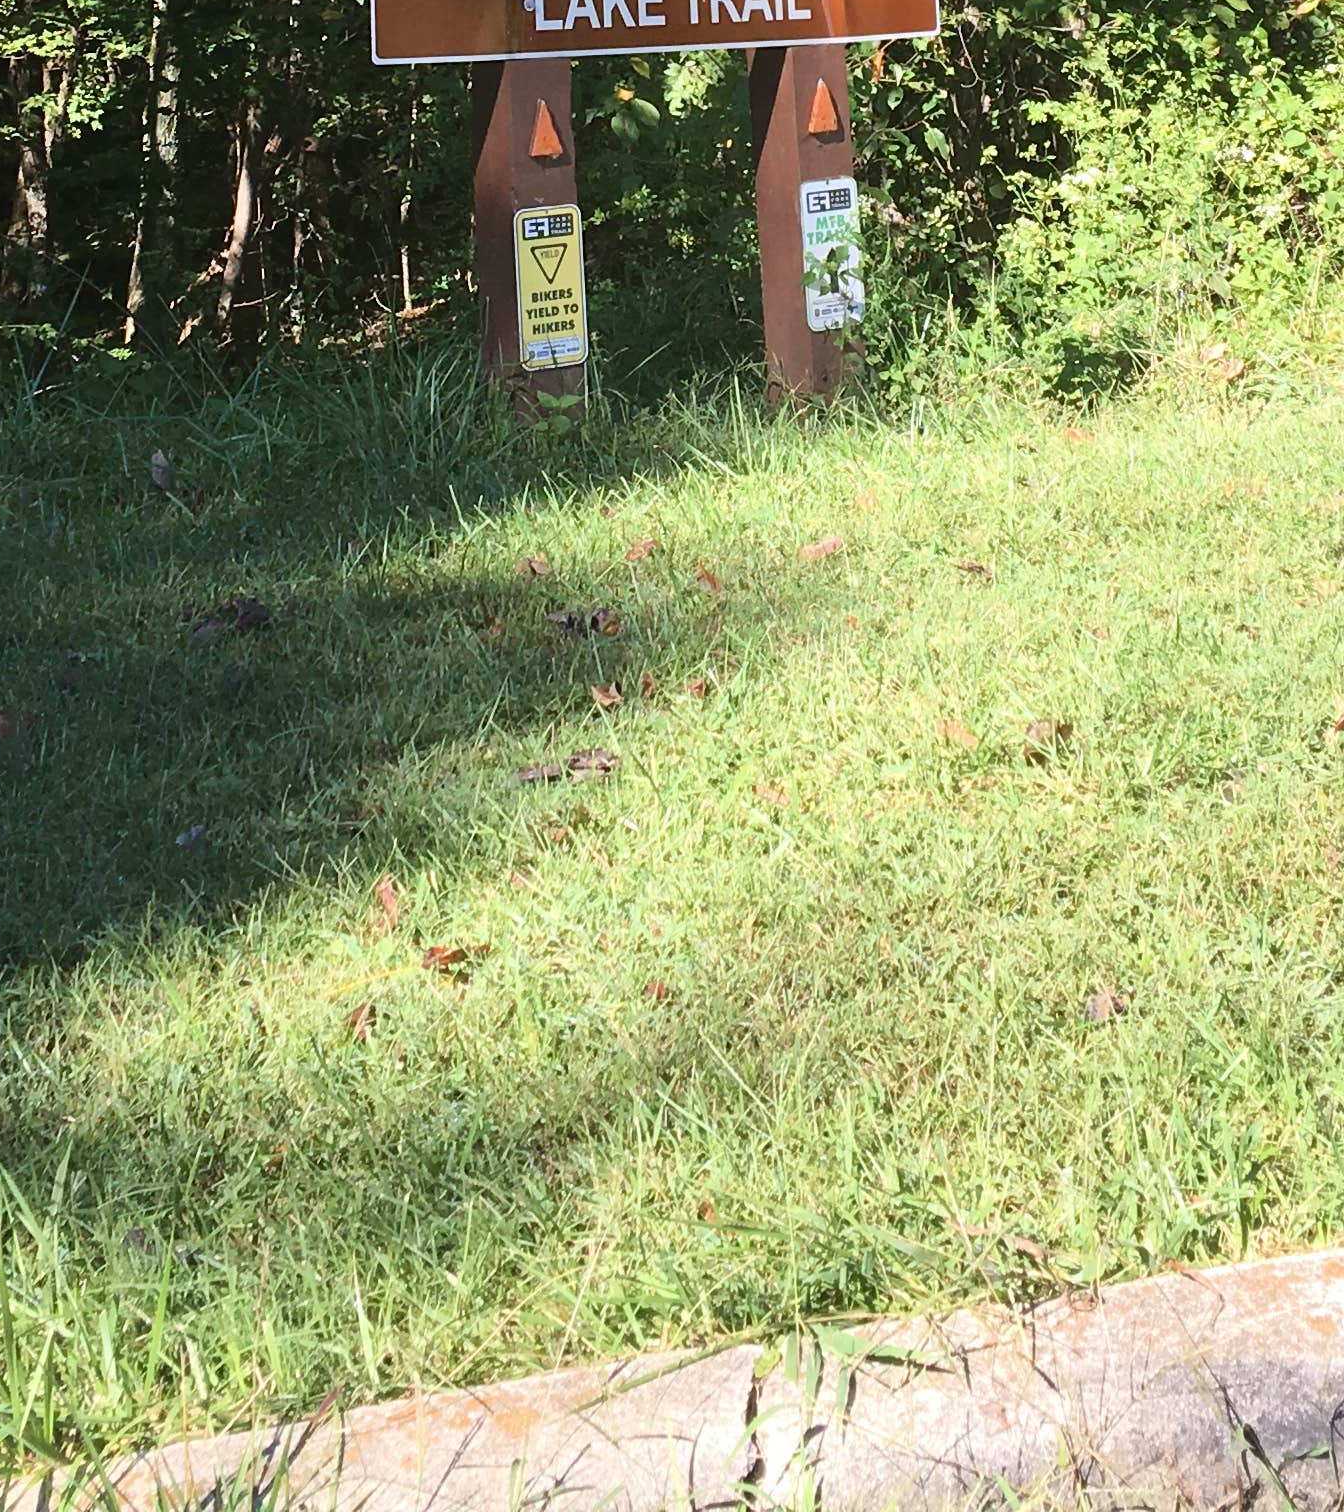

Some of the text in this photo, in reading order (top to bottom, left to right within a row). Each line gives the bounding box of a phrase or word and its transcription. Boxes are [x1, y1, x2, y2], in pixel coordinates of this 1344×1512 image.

[540, 249, 560, 259] YIELD
[531, 288, 573, 303] BIKERS
[525, 304, 579, 320] YIELD TO
[532, 320, 575, 335] HIKERS
